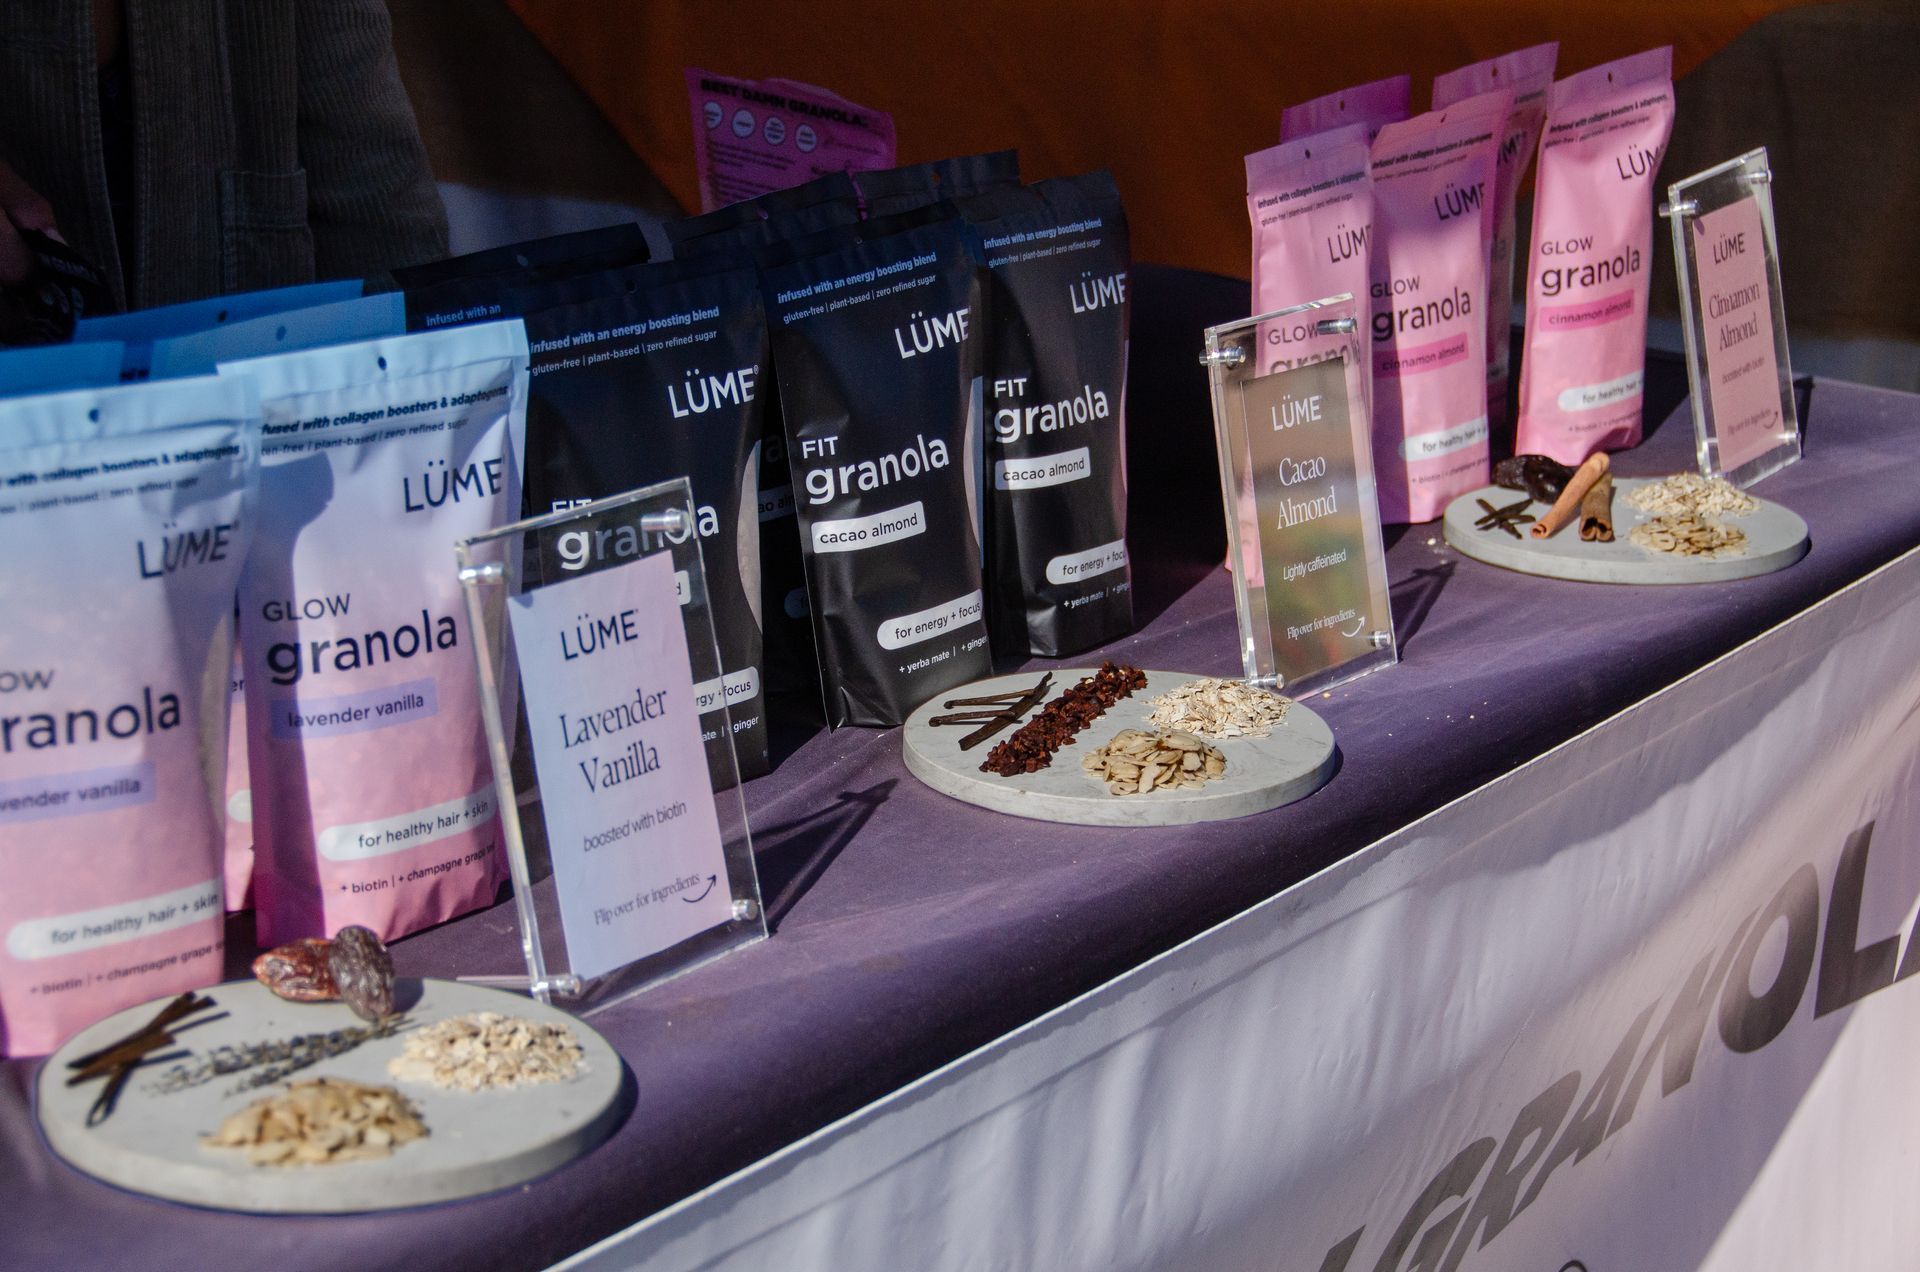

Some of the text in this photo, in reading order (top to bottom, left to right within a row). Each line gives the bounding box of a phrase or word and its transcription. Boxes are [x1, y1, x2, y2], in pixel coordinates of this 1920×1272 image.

[983, 217, 1102, 250] infused with an energy boosting blend
[1541, 236, 1593, 255] GLOW
[1713, 232, 1746, 265] LÜME
[777, 252, 937, 304] infused with an energy boosting blend
[1370, 276, 1420, 298] GLOW
[1541, 245, 1640, 296] granola
[426, 309, 464, 327] infused
[466, 305, 487, 319] with
[783, 274, 937, 325] gluten-free plant-based zero refined sugar
[1373, 287, 1471, 341] granola
[1549, 310, 1603, 324] cinnamon
[1709, 282, 1760, 320] Cinnamon
[530, 306, 720, 354] infused with an energy boosting blend
[895, 309, 970, 359] LÜME
[1719, 311, 1759, 351] Almond
[532, 330, 717, 376] gluten-free plant-based zero refined sugar
[1382, 352, 1437, 371] cinnamon
[1438, 343, 1465, 361] almond
[994, 378, 1027, 398] FIT
[1583, 391, 1596, 403] for
[302, 417, 330, 432] with
[333, 408, 385, 428] collagen
[387, 399, 438, 417] boosters
[441, 396, 448, 409] &
[994, 384, 1109, 443] granola
[1271, 394, 1322, 431] LÜME
[315, 432, 377, 450] plant-based
[384, 427, 406, 440] zero
[409, 422, 444, 435] refined
[802, 436, 838, 459] FIT
[1422, 442, 1437, 453] for
[1439, 434, 1464, 448] healthy
[403, 458, 504, 513] LÜME
[805, 434, 950, 505] granola
[1003, 457, 1085, 481] cacao almond
[1279, 456, 1326, 486] Cacao
[1277, 485, 1338, 530] Almond
[820, 513, 918, 544] cacao almond
[1063, 557, 1105, 576] for energy
[1283, 548, 1347, 581] Lightly caffeinated
[262, 593, 350, 622] GLOW
[1071, 590, 1104, 608] yerba mate
[561, 609, 638, 660] LÜME
[895, 602, 981, 640] for energy focus
[1287, 608, 1356, 640] Flip over for ingredients
[267, 609, 457, 685] granola
[906, 658, 930, 674] yerba
[931, 651, 950, 665] mate
[723, 681, 751, 697] focus
[288, 693, 424, 727] lavender vanilla
[559, 688, 667, 749] Lavender
[733, 716, 759, 733] ginger
[579, 740, 661, 793] Vanilla
[77, 778, 141, 802] vanilla
[358, 800, 489, 848] for healthy hair skin
[583, 801, 687, 852] boosted with biotin
[352, 857, 463, 894] biotin champagne
[594, 873, 700, 925] Flip over for ingredients
[51, 929, 77, 945] for
[82, 915, 144, 938] healthy
[148, 906, 177, 924] hair
[106, 954, 178, 981] champagne
[1372, 821, 1920, 1272] GRANOL
